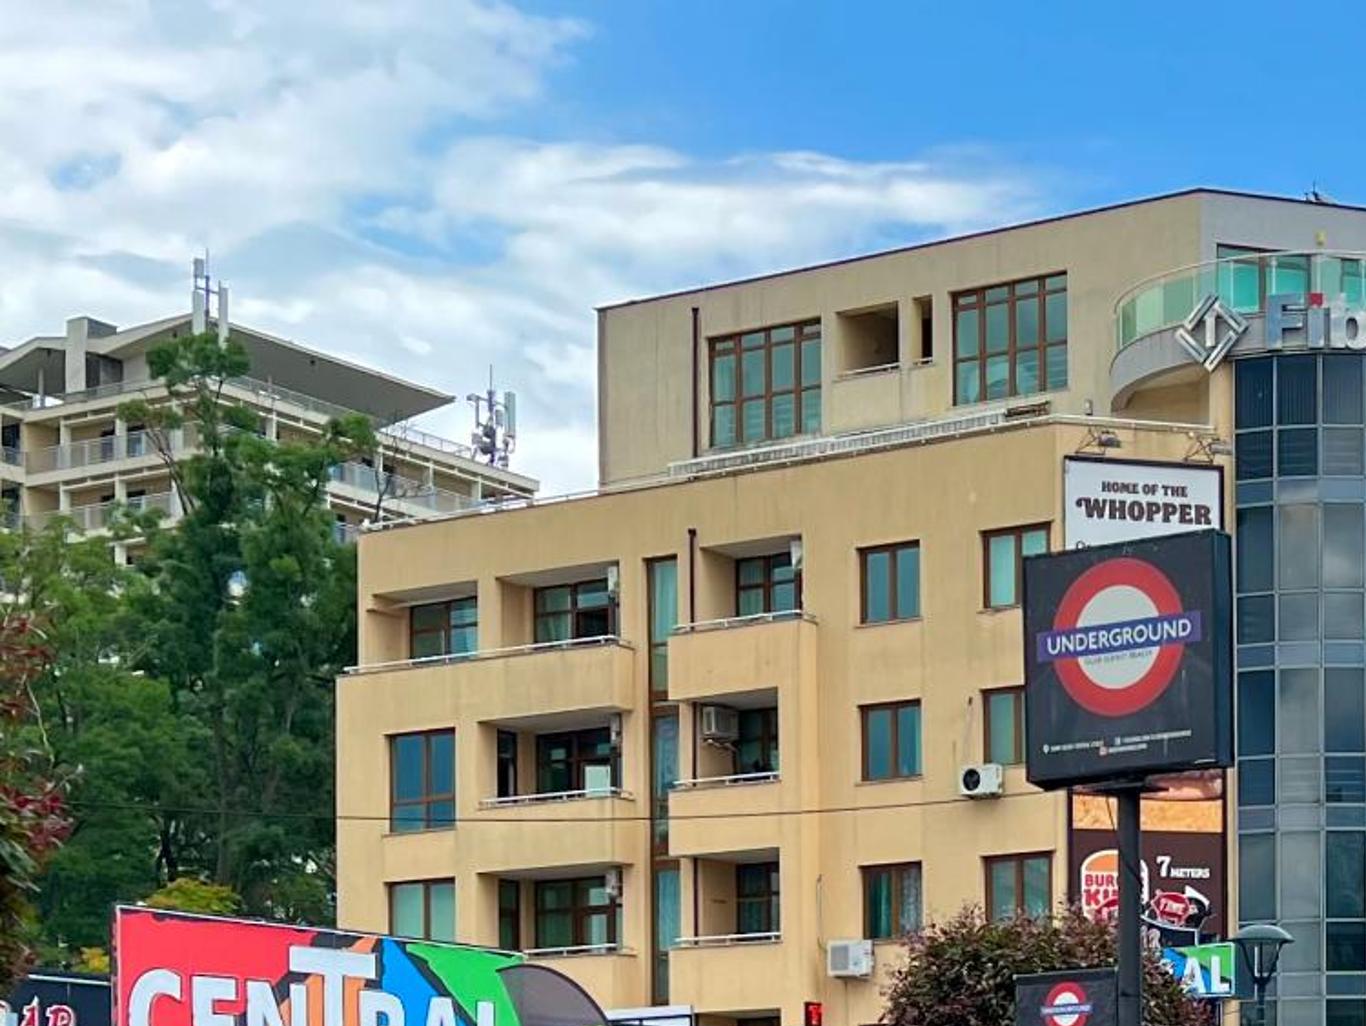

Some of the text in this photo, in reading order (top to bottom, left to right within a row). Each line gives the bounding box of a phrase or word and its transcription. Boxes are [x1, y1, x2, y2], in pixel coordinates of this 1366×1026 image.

[1101, 480, 1188, 498] HOME OF THE
[1075, 497, 1212, 525] WHOPPER
[1046, 618, 1192, 655] UNDERGROUND
[1156, 855, 1171, 878] 7
